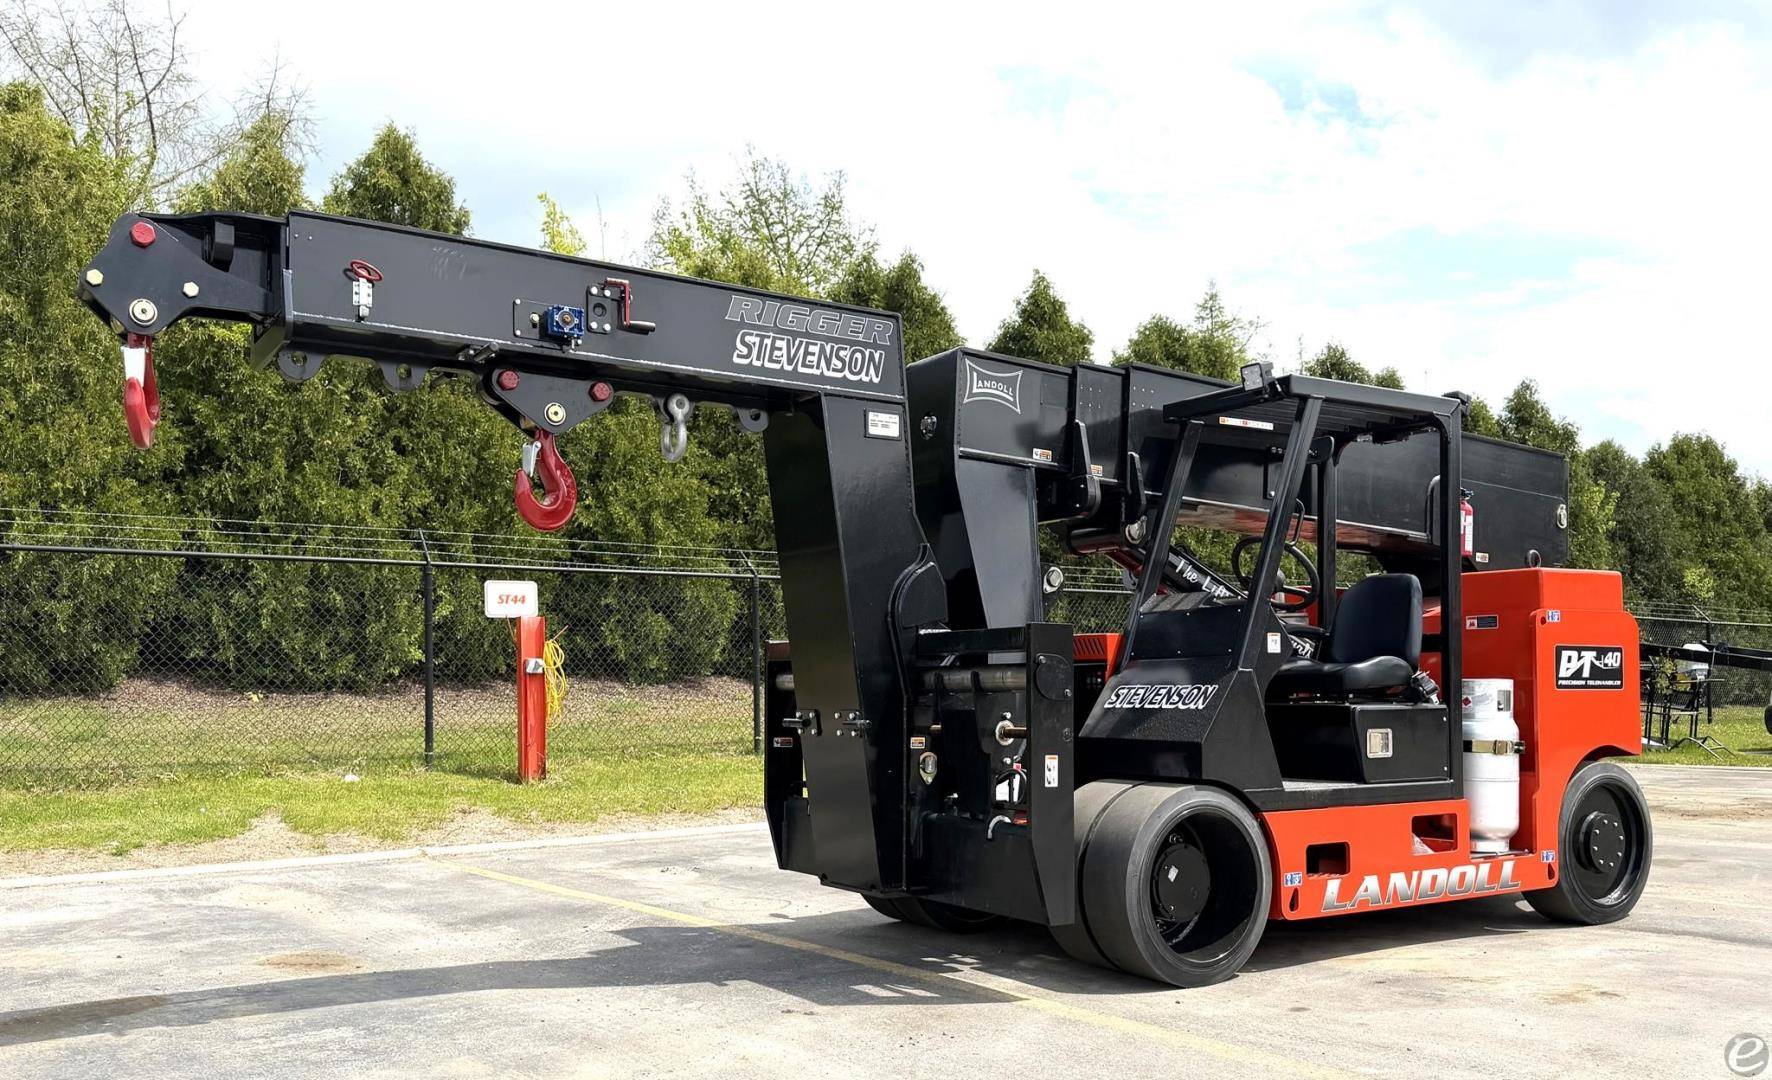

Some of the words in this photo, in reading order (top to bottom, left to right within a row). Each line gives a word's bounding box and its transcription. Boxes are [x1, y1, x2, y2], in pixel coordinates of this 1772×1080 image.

[725, 295, 894, 345] RIGGER
[732, 329, 885, 383] STEVENSON
[972, 370, 1015, 401] LANDOLL
[1175, 556, 1199, 583] The
[497, 594, 526, 605] ST44
[1103, 684, 1219, 709] STEVENSON
[1321, 860, 1521, 912] LANDOLL
